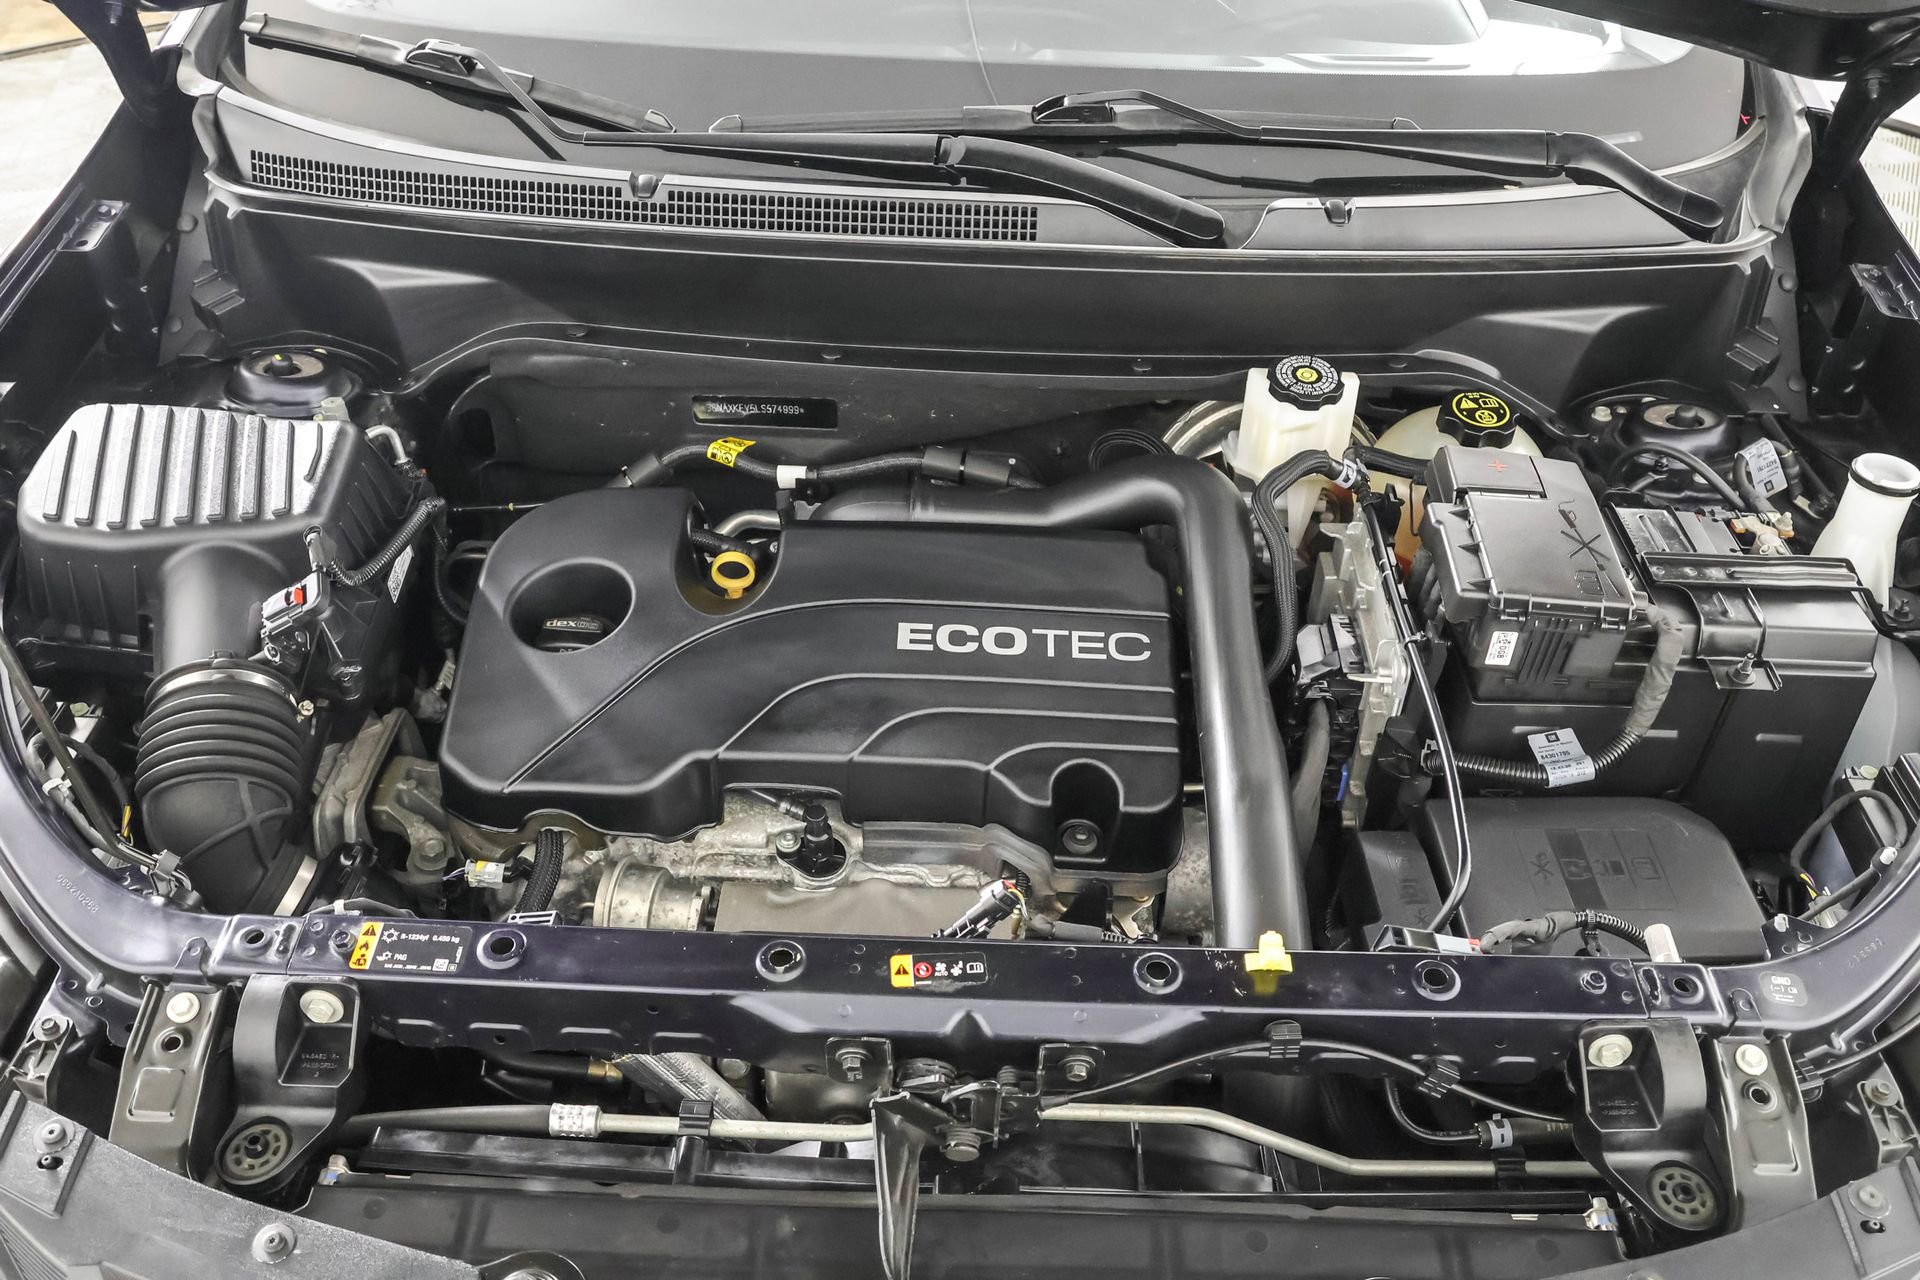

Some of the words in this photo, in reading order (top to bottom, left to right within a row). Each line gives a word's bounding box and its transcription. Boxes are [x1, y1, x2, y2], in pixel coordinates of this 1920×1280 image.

[897, 622, 1151, 662] ECOTEC
[400, 932, 429, 943] R-1234yf
[432, 934, 450, 942] 0.450
[451, 936, 460, 944] kg
[393, 953, 407, 961] PAG
